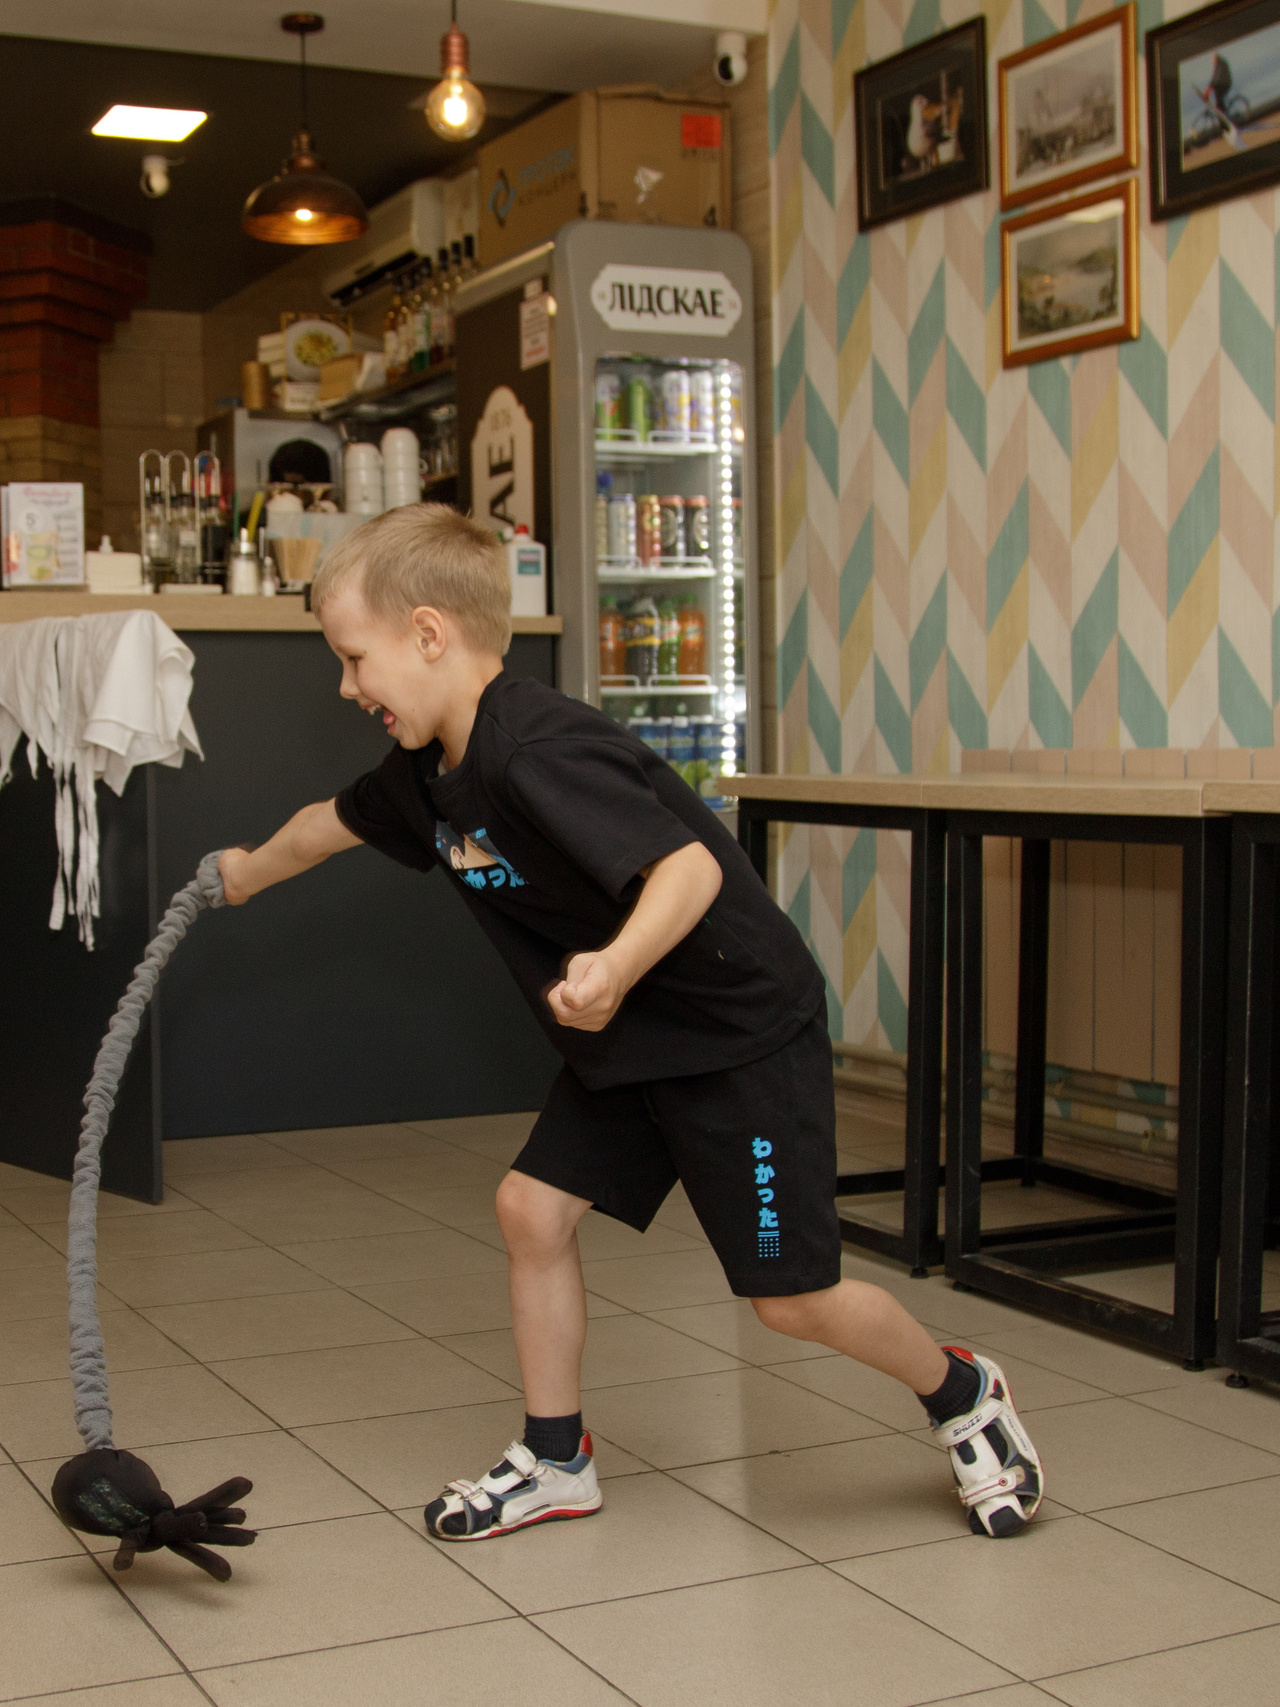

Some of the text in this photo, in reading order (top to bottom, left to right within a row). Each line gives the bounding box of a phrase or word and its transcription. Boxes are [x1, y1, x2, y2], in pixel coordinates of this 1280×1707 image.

[608, 281, 726, 319] ЛІДСКАЕ
[751, 1136, 779, 1229] わかった
